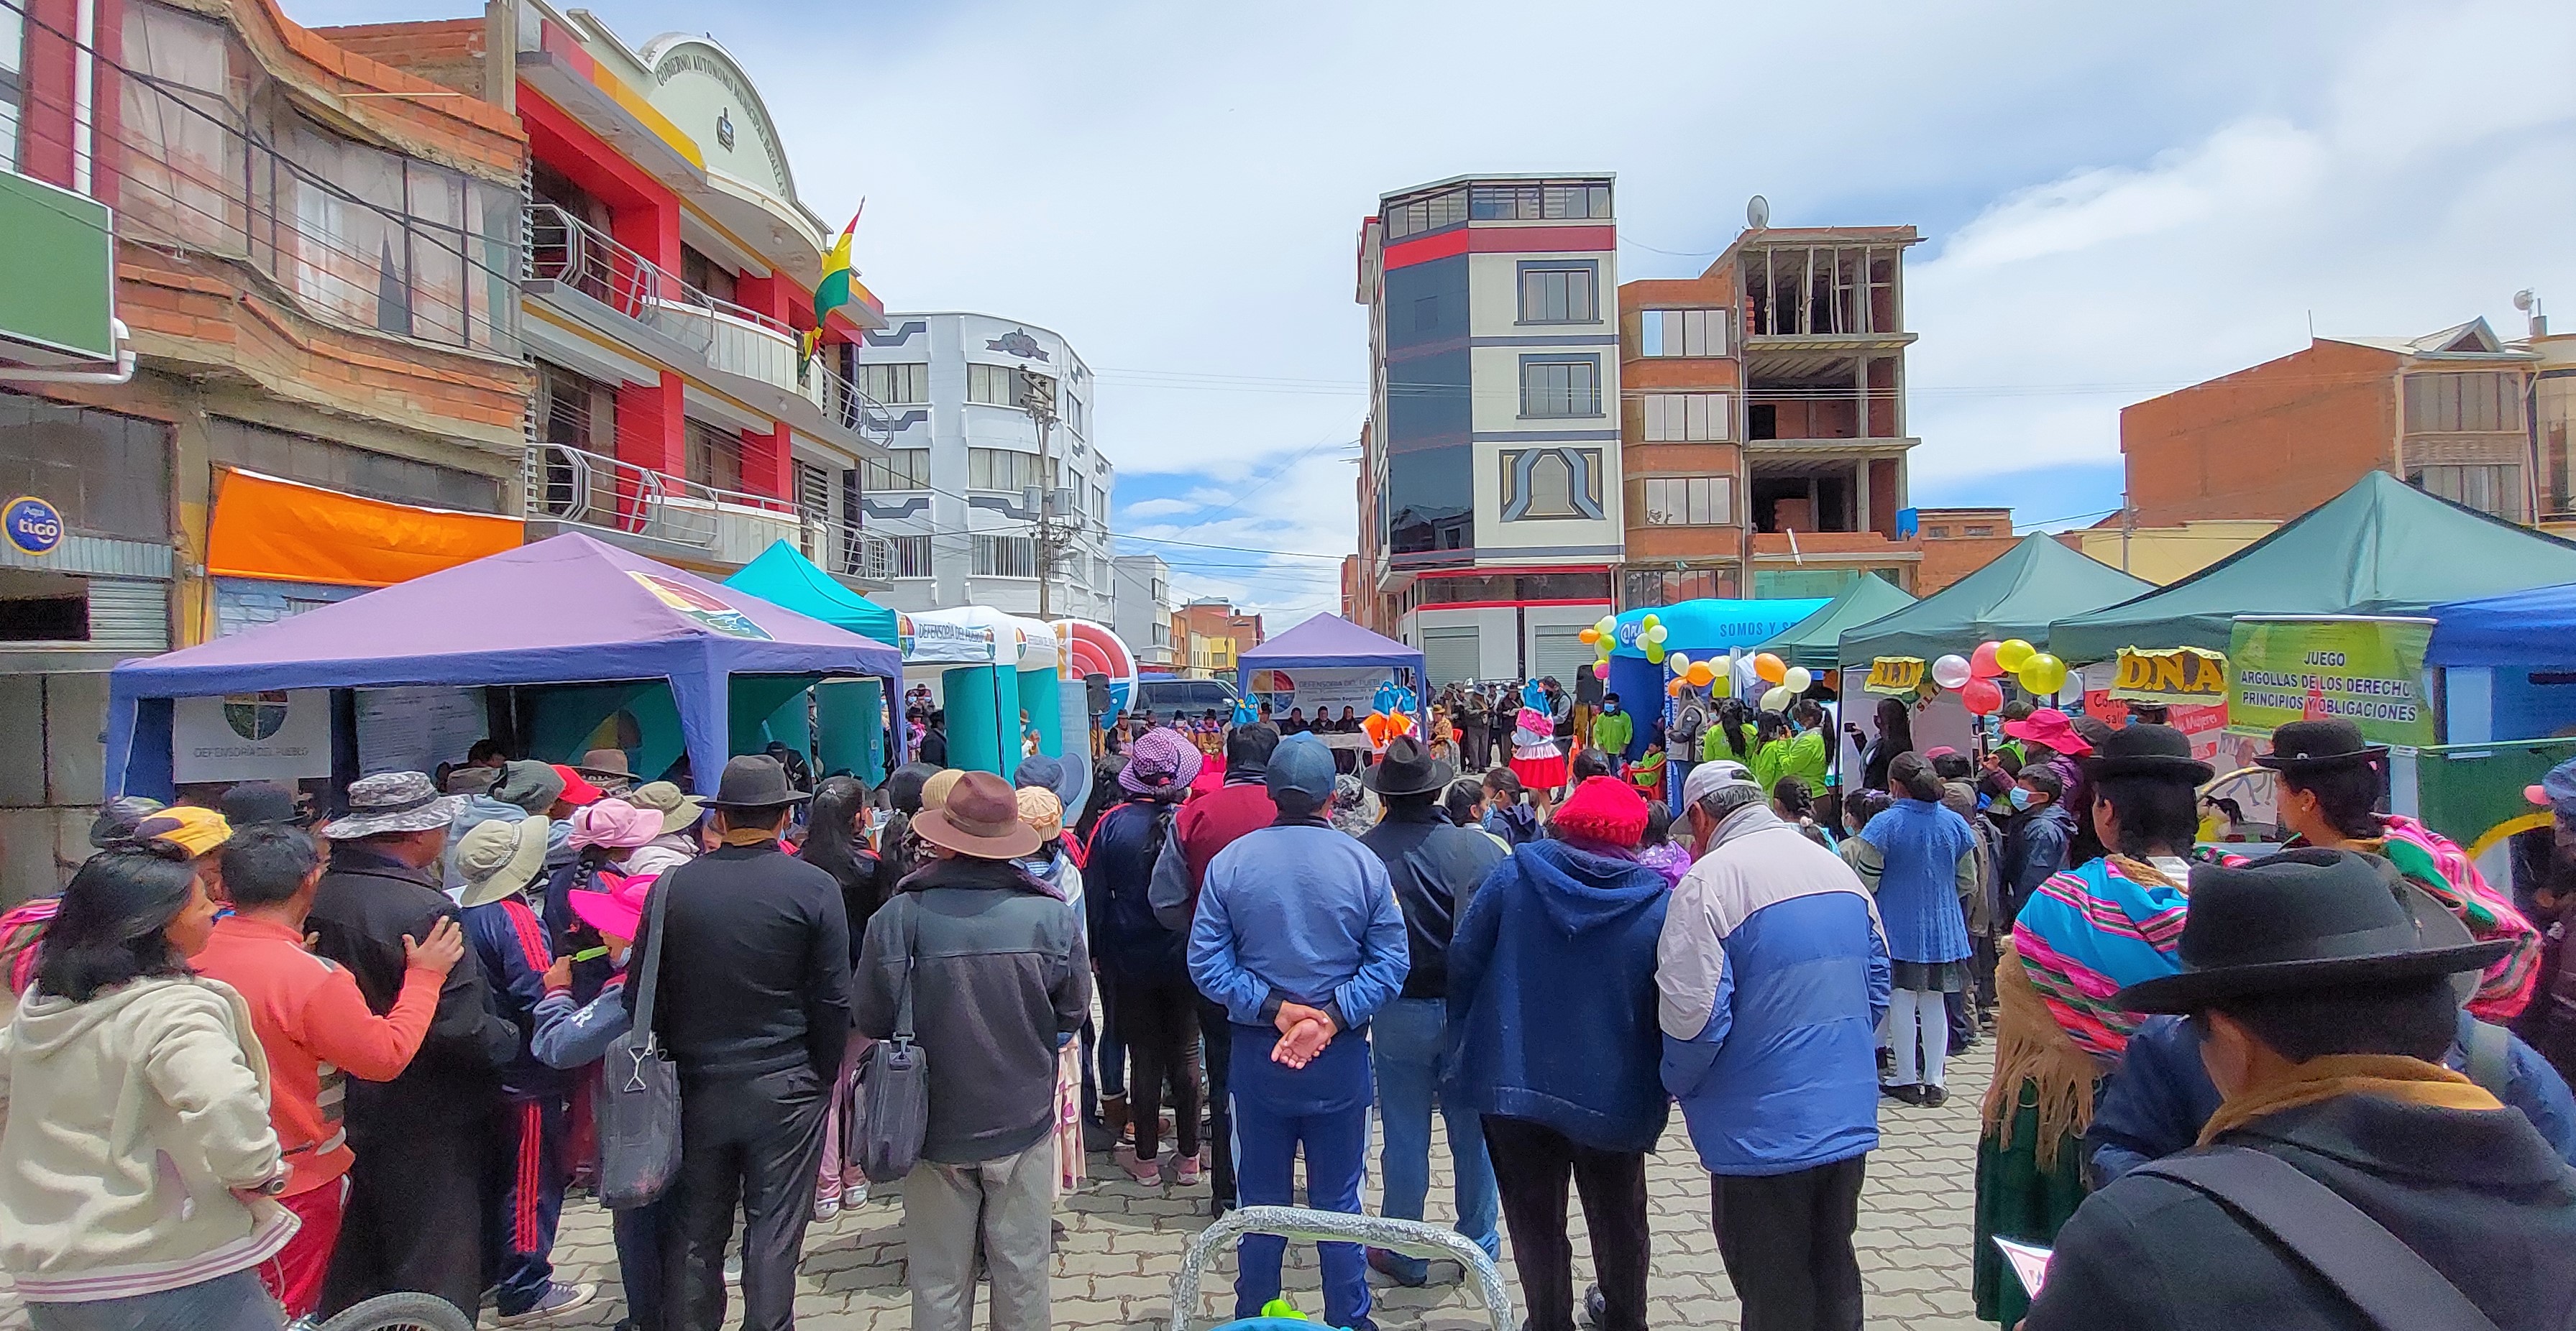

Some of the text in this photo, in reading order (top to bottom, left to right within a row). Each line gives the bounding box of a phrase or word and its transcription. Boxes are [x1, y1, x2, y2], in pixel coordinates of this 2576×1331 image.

[656, 54, 785, 197] GOBIERNO AUTONOMO MUNICIPAL BATALLAS
[1720, 622, 1763, 637] SOMOS
[1769, 622, 1776, 635] Y
[2304, 652, 2346, 666] JUEGO
[2241, 671, 2298, 688] ARGOLLAS
[2301, 674, 2316, 689] DE
[2320, 676, 2342, 691] LOS
[2242, 691, 2416, 722] PRINCIPIOS Y OBLIGACIONES
